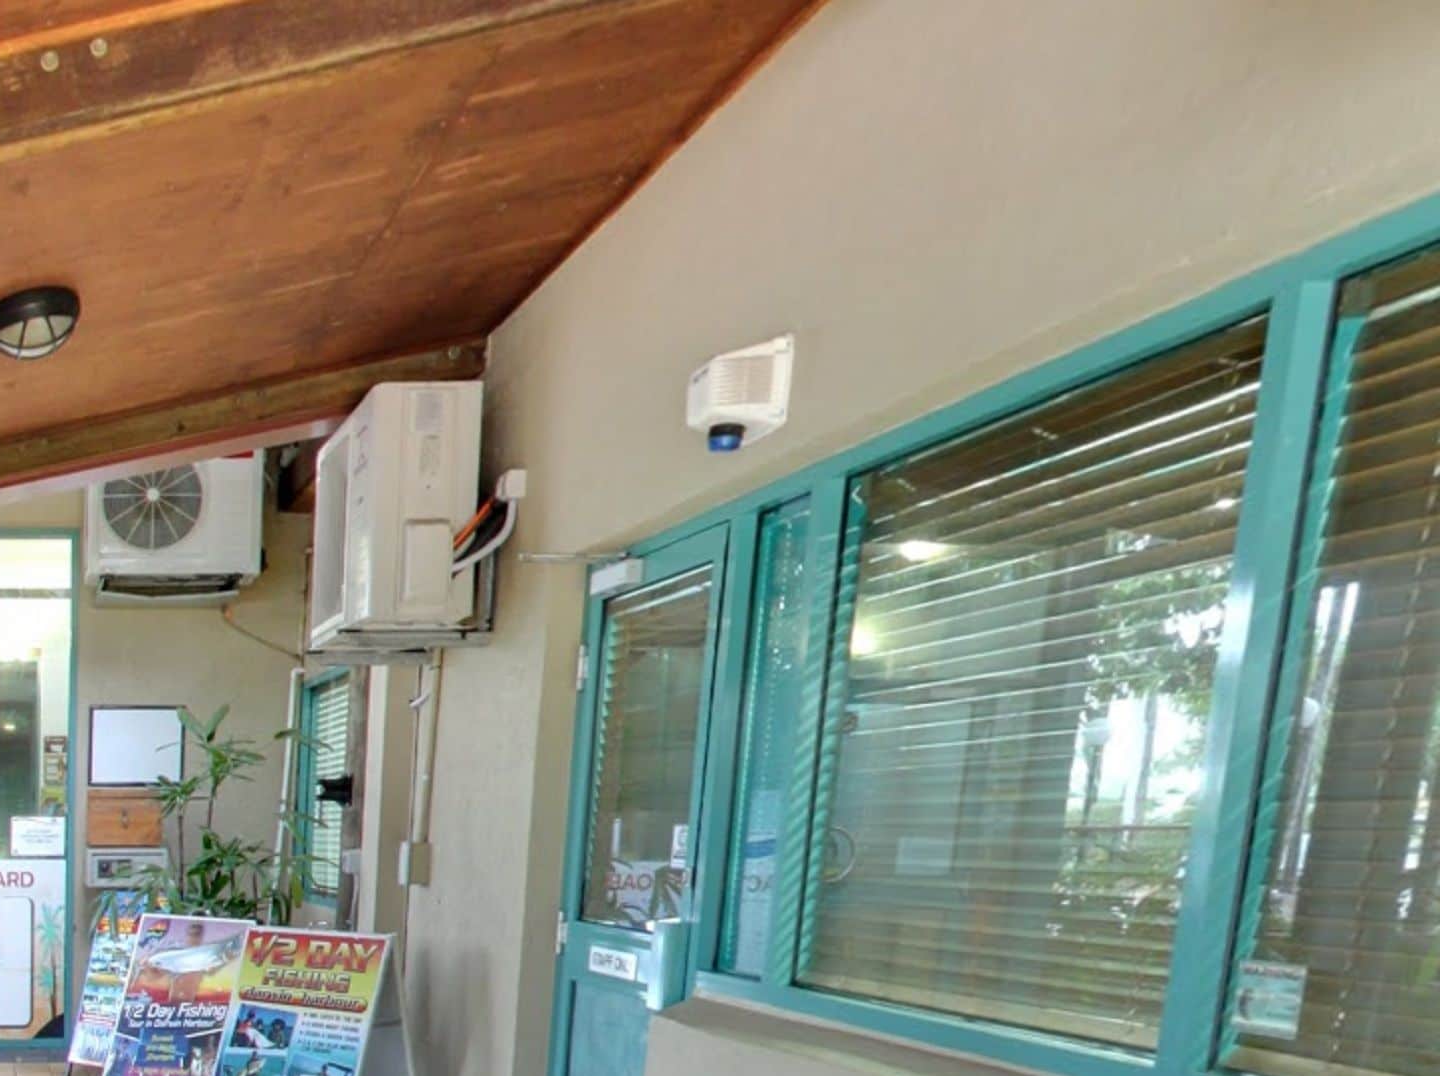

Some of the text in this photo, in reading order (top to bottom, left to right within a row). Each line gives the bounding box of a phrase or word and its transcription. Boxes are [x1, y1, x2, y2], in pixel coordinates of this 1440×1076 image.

[250, 934, 378, 974] 1/2 DAY
[262, 968, 351, 993] FISHING
[147, 1002, 176, 1022] Day
[177, 1002, 228, 1021] Fishing
